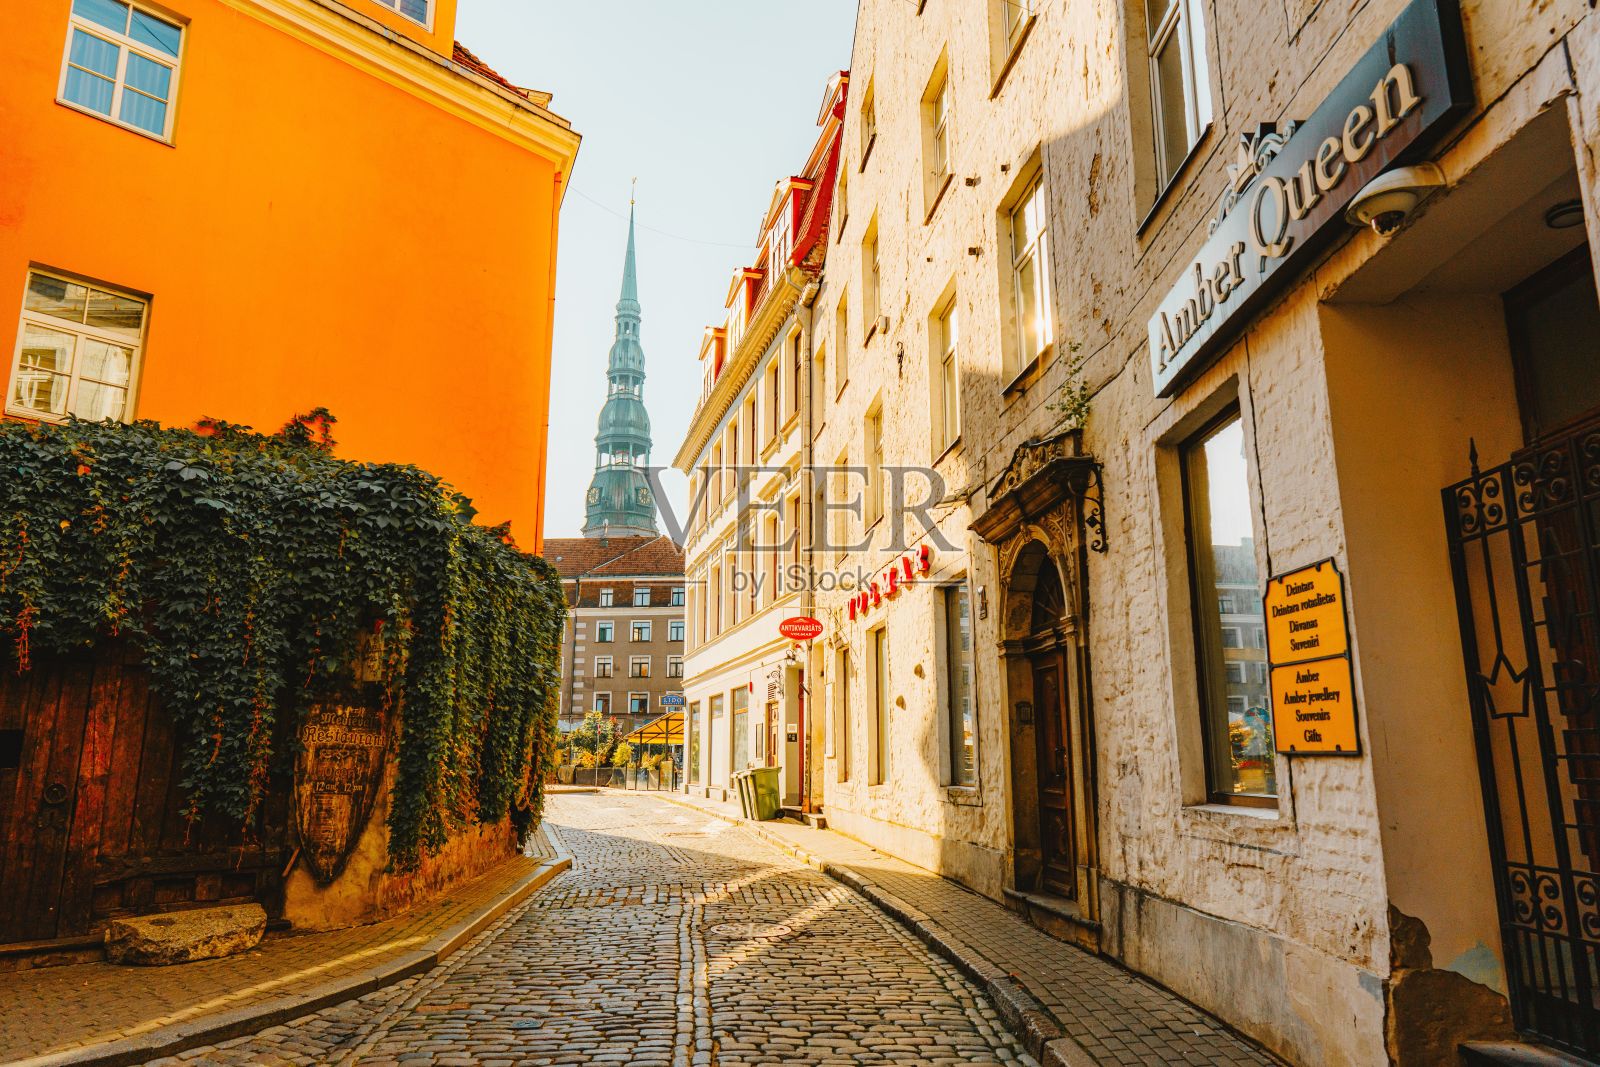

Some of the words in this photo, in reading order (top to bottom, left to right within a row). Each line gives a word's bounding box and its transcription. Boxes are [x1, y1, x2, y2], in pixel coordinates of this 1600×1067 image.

[1157, 241, 1245, 375] Amber
[1252, 63, 1421, 273] Queen
[1296, 669, 1320, 684] Amber
[1284, 690, 1307, 705] Amber
[1308, 687, 1340, 705] jewellery
[1295, 708, 1331, 722] Souvenirs
[302, 724, 386, 747] Restaurant
[1304, 729, 1322, 743] Gifts
